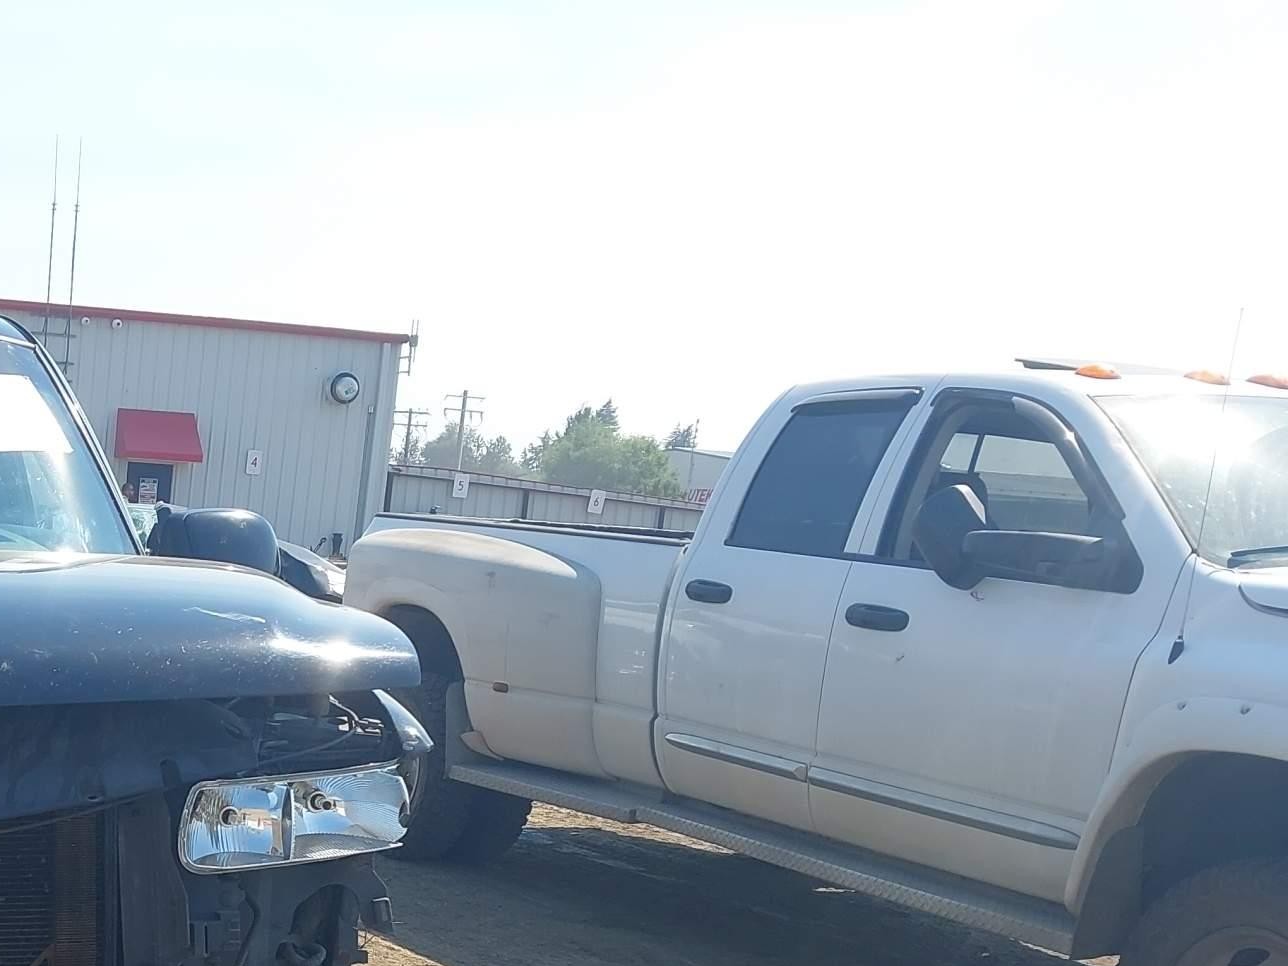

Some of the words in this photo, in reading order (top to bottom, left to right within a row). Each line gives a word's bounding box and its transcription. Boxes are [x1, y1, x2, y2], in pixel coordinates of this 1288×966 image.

[250, 456, 258, 468] 4
[458, 480, 465, 492] 5
[593, 496, 600, 508] 6
